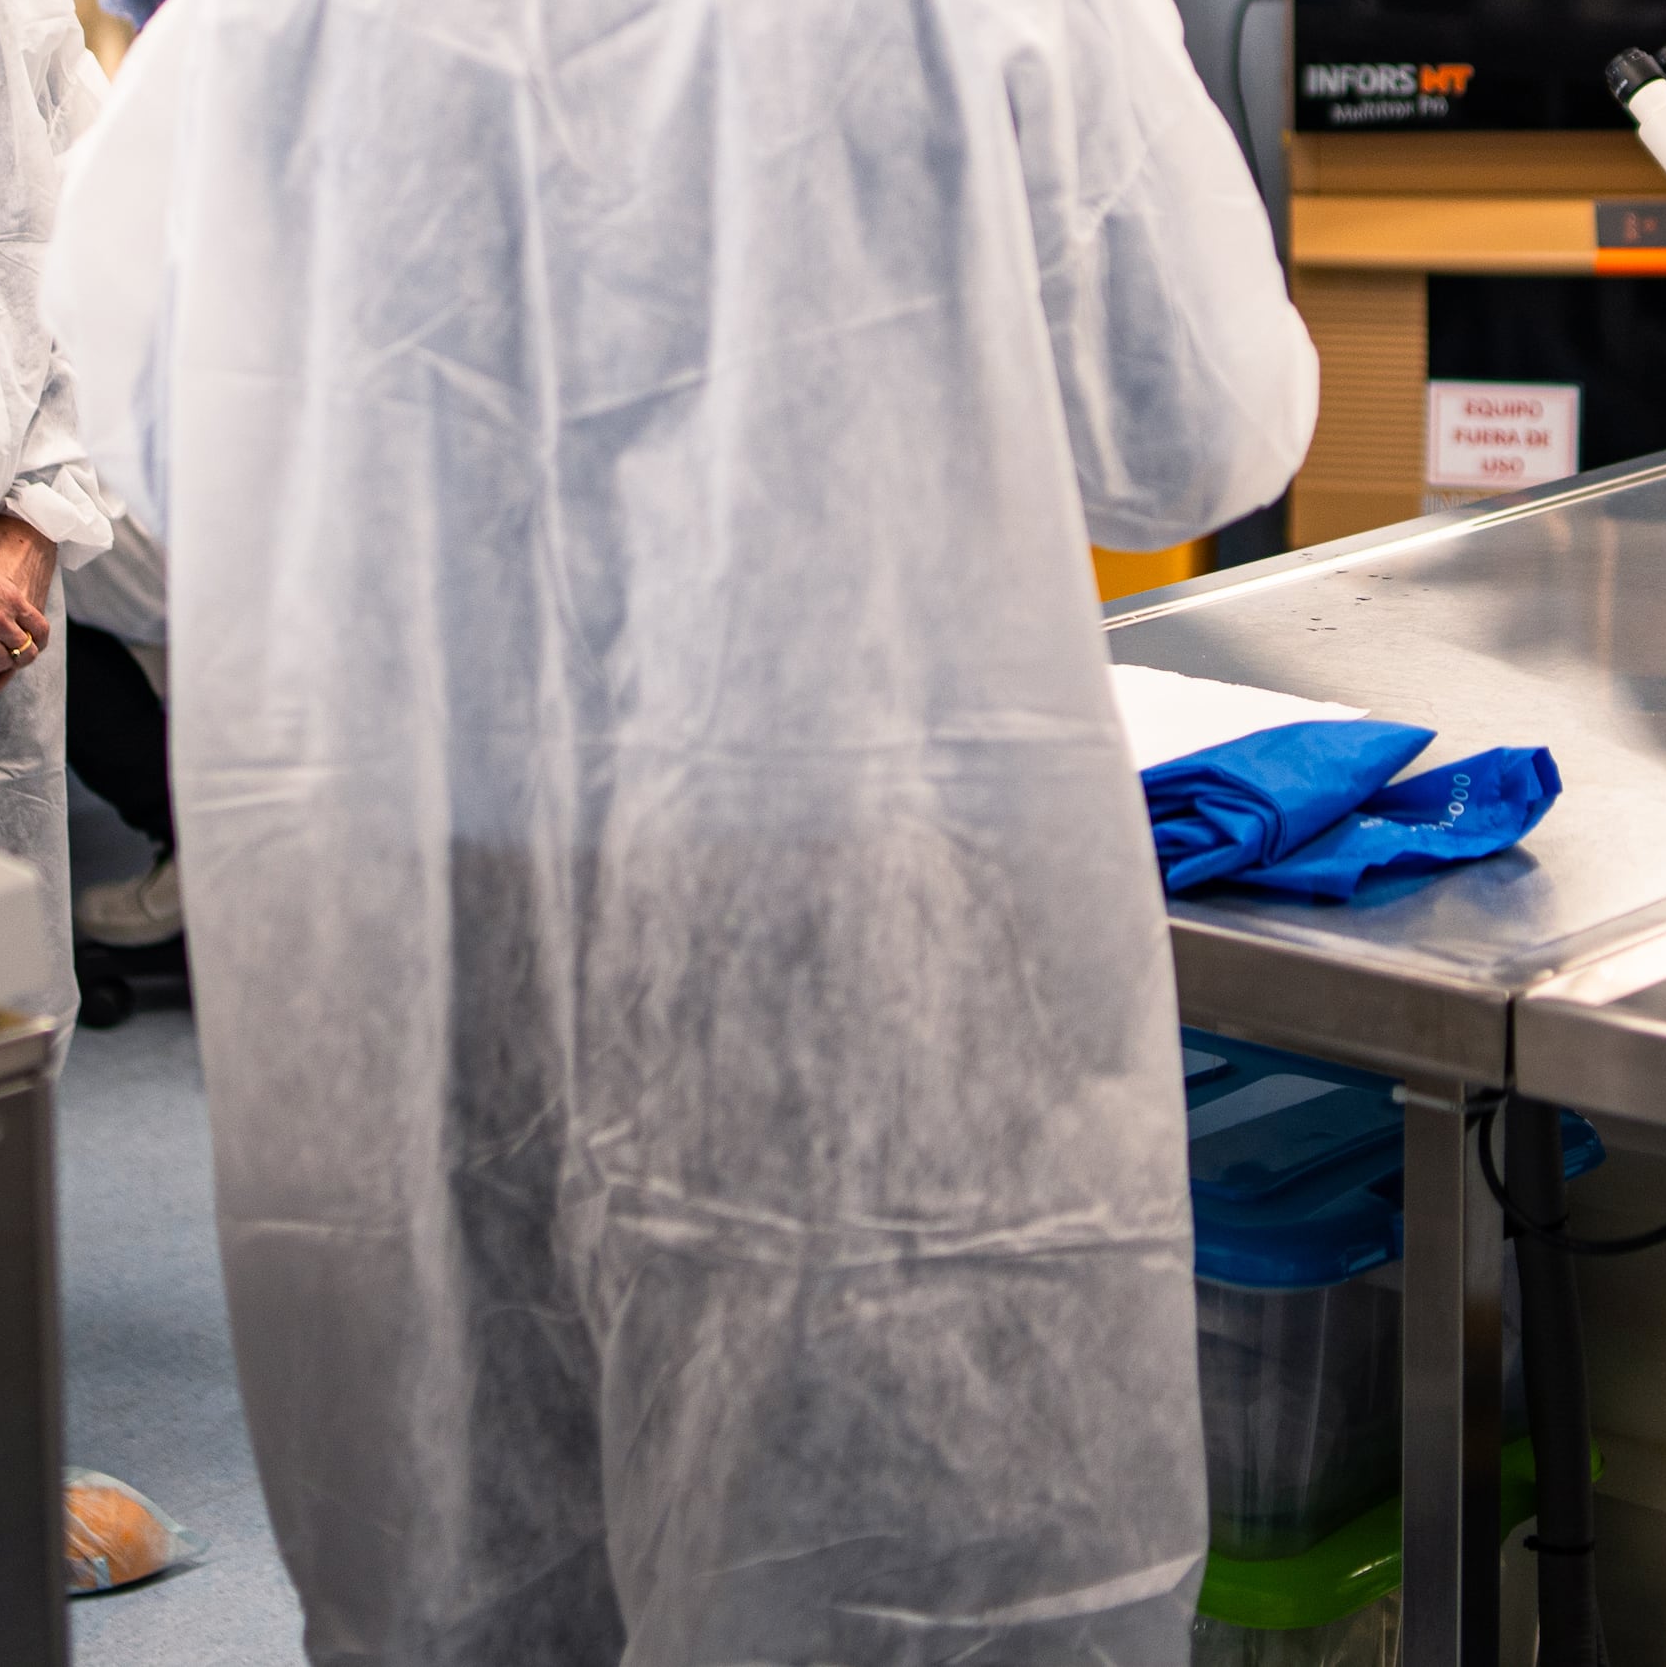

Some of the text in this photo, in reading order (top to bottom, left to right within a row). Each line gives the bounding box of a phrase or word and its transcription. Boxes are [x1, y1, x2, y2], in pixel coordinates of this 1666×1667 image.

[1306, 64, 1416, 95] INFORS
[1464, 399, 1543, 421] EQUIPO
[1454, 429, 1550, 448] FUERA DE
[1482, 456, 1525, 477] USO
